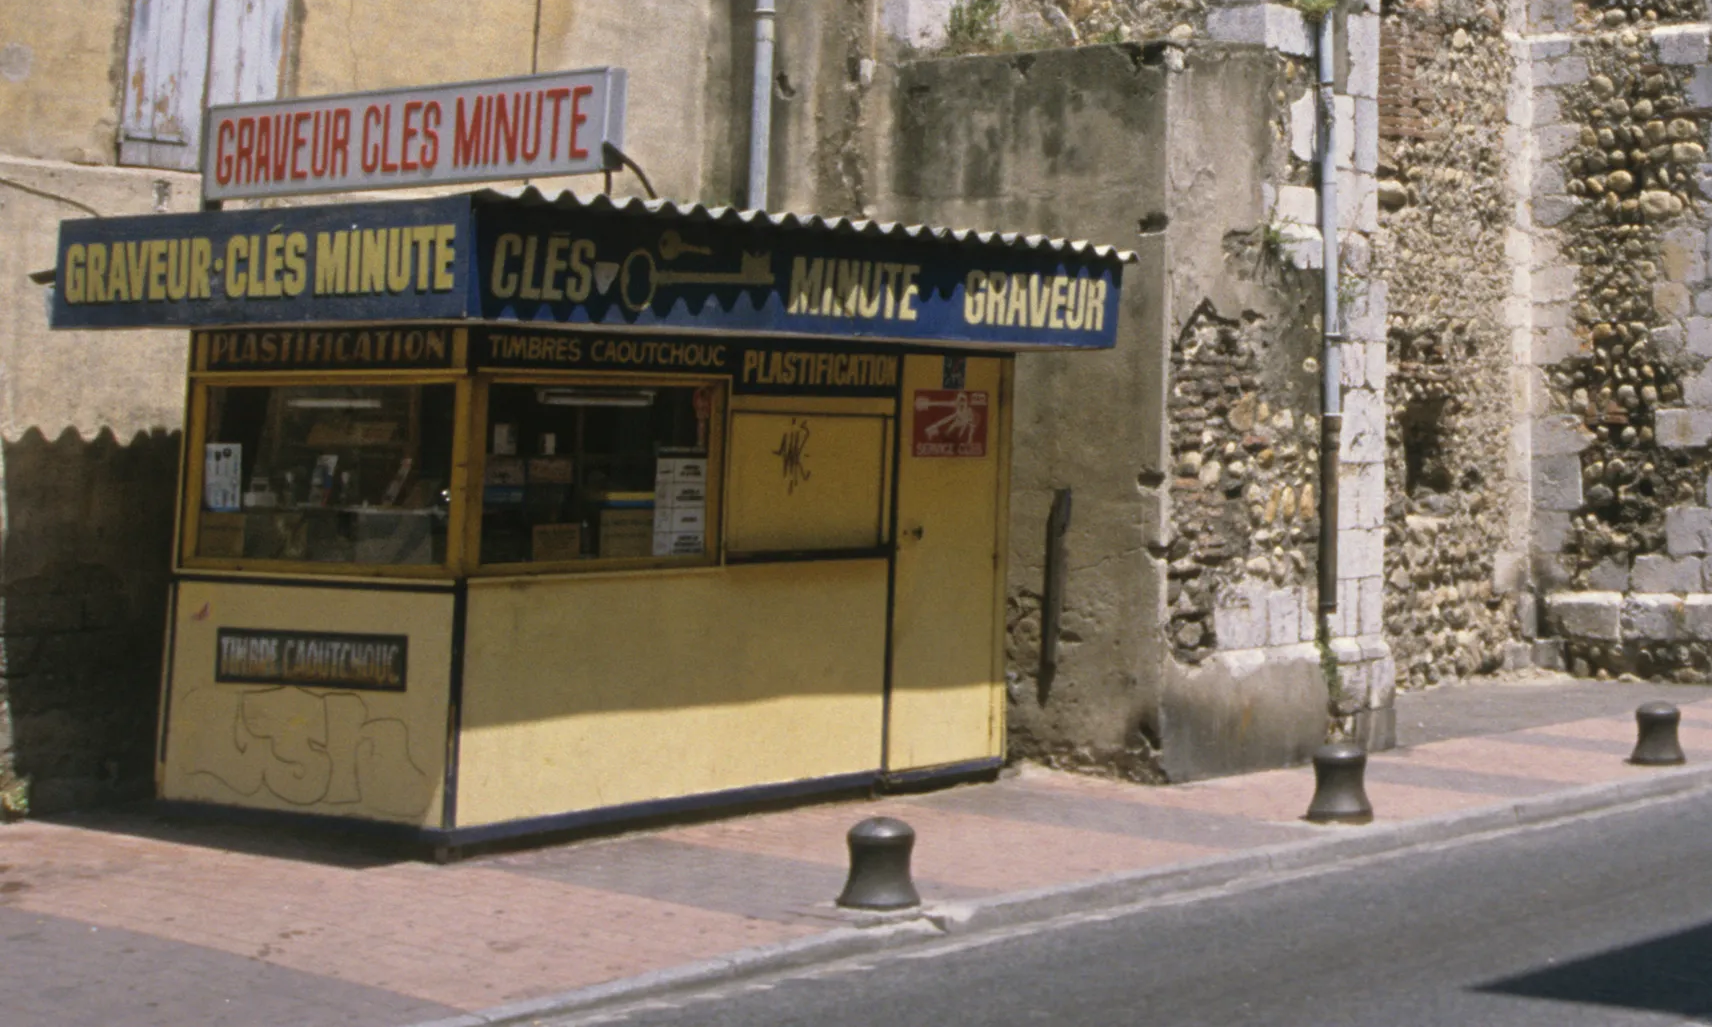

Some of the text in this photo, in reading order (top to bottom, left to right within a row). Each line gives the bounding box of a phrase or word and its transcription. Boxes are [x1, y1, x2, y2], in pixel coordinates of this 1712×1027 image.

[215, 85, 594, 186] GRAVEUR CLES MINUTE
[65, 236, 212, 305] GRAVEUR
[313, 224, 457, 296] MINUTE
[787, 257, 921, 322] MINUTE
[963, 269, 1108, 331] GRAVEUR
[211, 328, 446, 364] PLASTIFICATION
[488, 335, 727, 367] TIMBRES CAOUTCHOUC
[742, 349, 899, 388] PLASTIFICATION
[283, 639, 400, 685] CAOUTCHOUC
